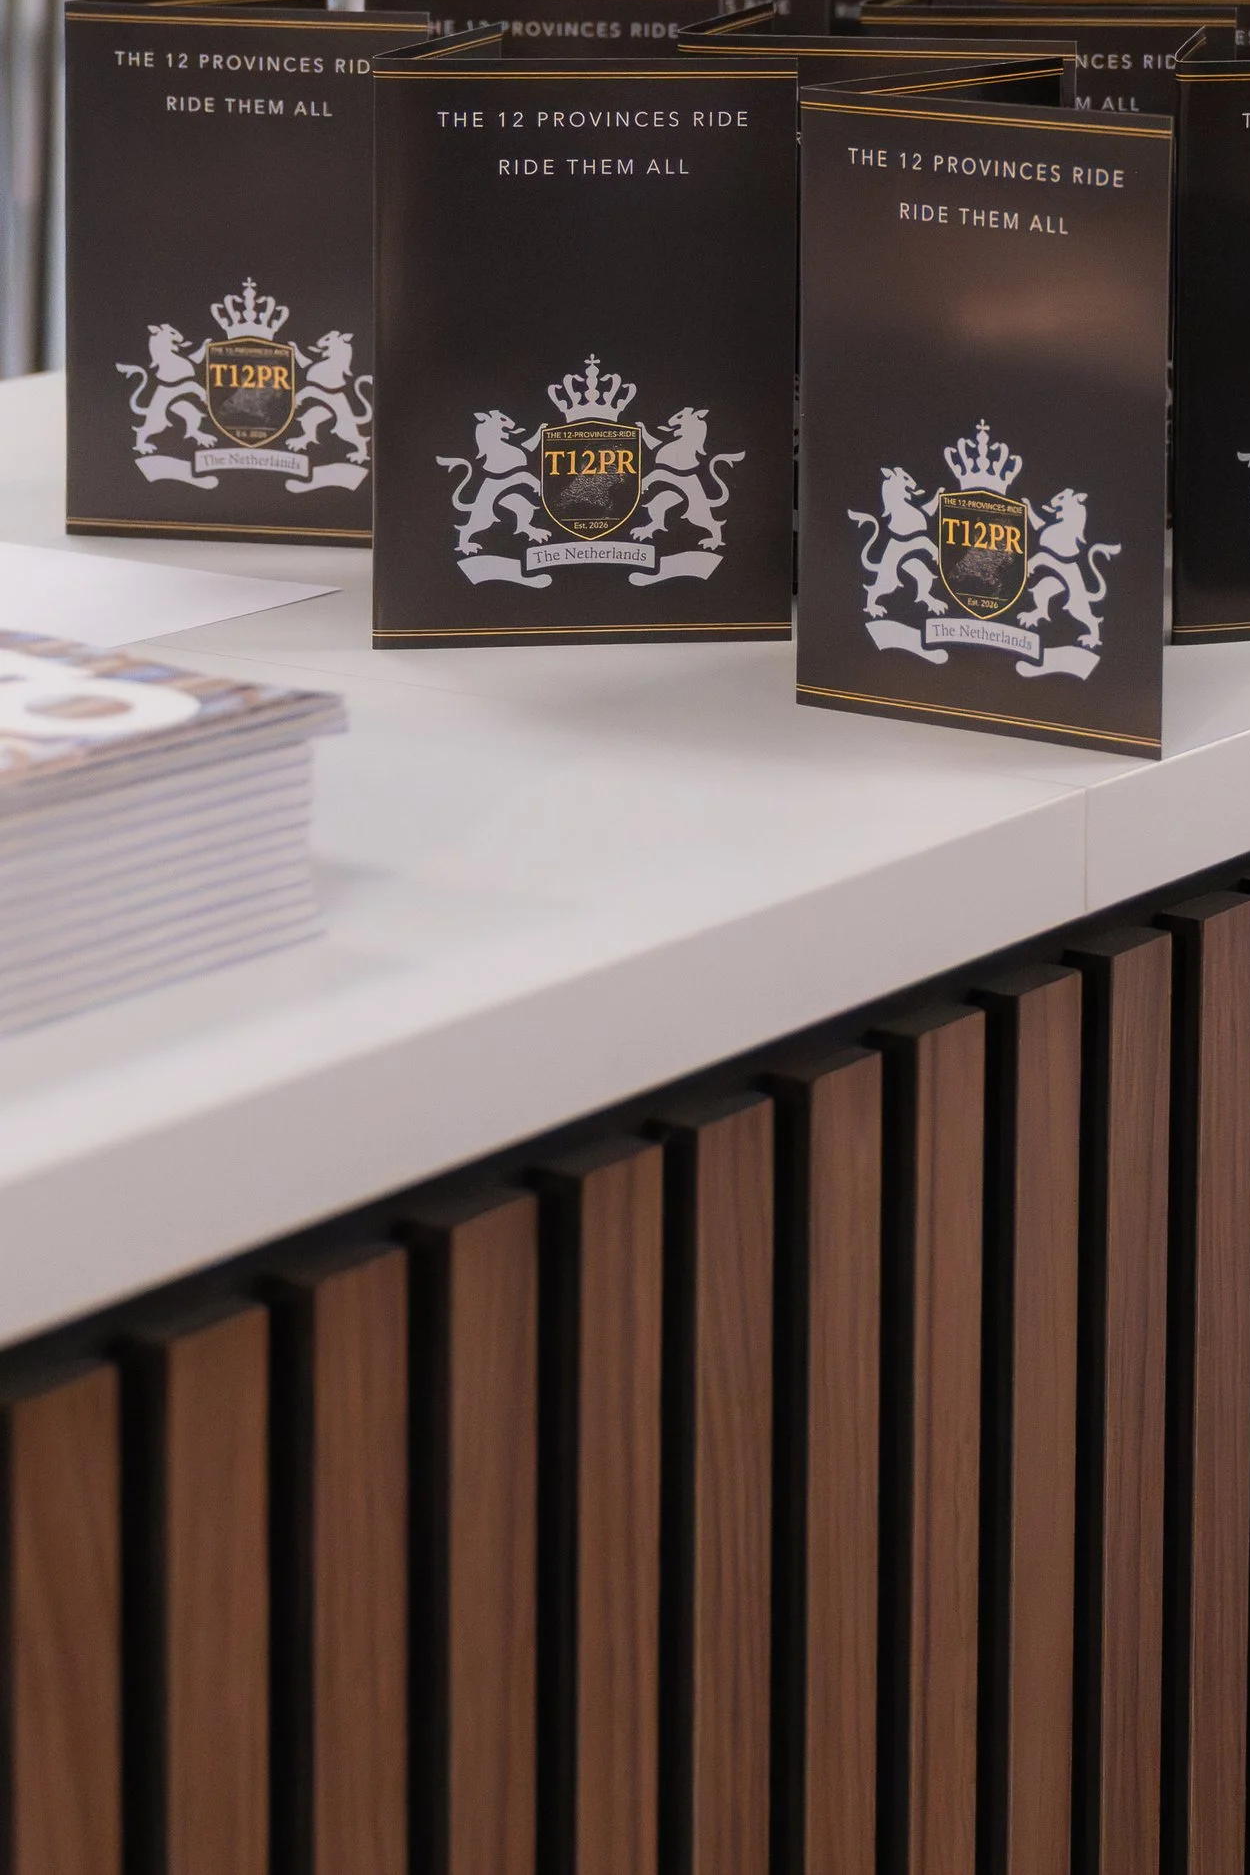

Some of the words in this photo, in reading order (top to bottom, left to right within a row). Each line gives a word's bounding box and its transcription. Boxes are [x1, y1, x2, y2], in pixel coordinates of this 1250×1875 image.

[631, 22, 679, 39] RIDE
[114, 51, 155, 68] THE
[166, 52, 189, 69] 12
[199, 54, 325, 74] PROVINCES
[166, 96, 215, 114] RIDE
[224, 98, 285, 116] THEM
[293, 100, 334, 118] ALL
[1101, 96, 1141, 112] ALL
[437, 111, 485, 128] THE
[497, 111, 525, 128] 12
[537, 111, 681, 128] PROVINCES
[693, 111, 749, 128] RIDE
[498, 158, 555, 176] RIDE
[566, 158, 635, 176] THEM
[645, 158, 691, 175] ALL
[847, 146, 889, 168] THE
[899, 151, 923, 172] 12
[934, 154, 1062, 184] PROVINCES
[1072, 166, 1126, 189] RIDE
[899, 201, 949, 224] RIDE
[958, 207, 1020, 231] THEM
[1028, 213, 1070, 236] ALL
[209, 363, 292, 391] T12PR
[545, 431, 562, 440] THE
[544, 449, 638, 477] T12PR
[573, 521, 588, 530] Est.
[588, 521, 609, 530] 2026
[942, 516, 1024, 556] T12PR
[532, 549, 562, 564] The
[564, 546, 648, 563] Netherlands
[931, 623, 956, 638] The
[959, 624, 1034, 652] Netherlands
